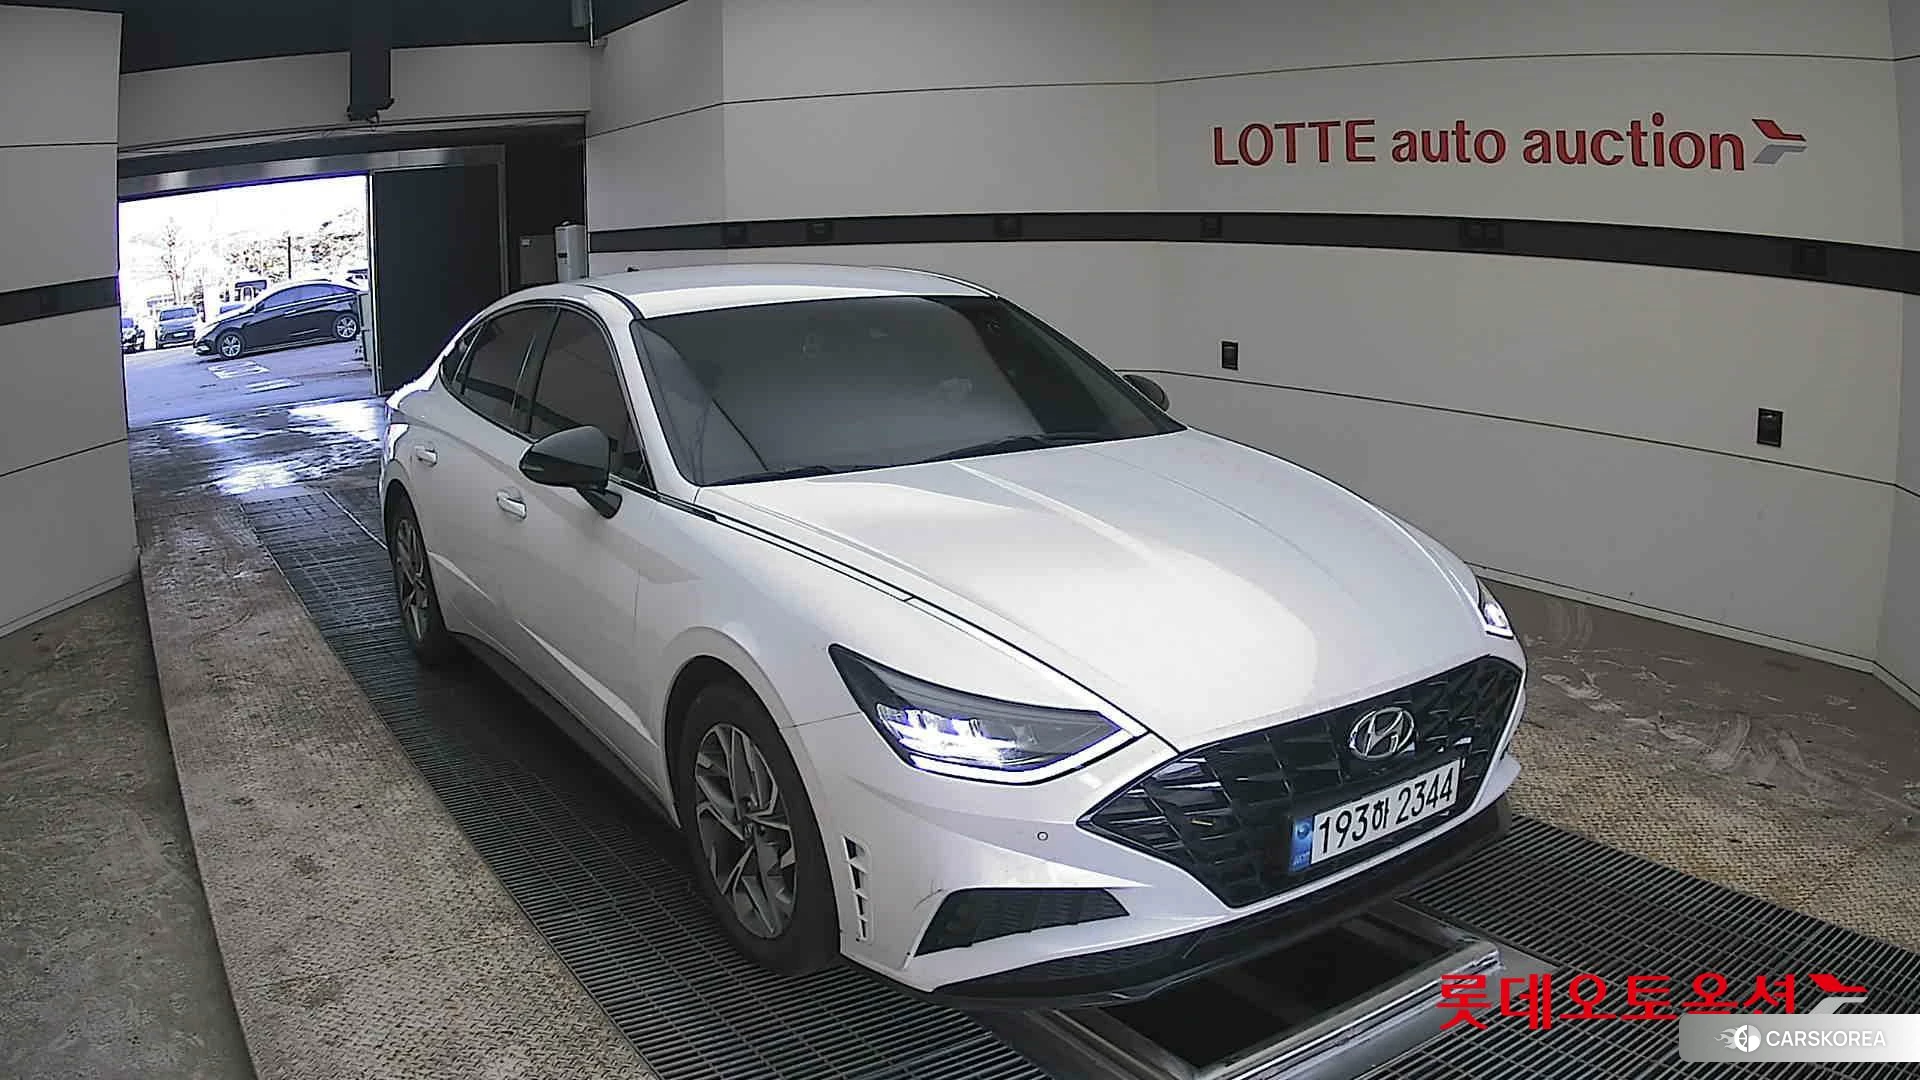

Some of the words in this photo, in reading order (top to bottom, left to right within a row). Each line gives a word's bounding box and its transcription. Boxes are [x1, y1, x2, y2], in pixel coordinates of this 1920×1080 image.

[1214, 119, 1376, 165] LOTTE
[1392, 121, 1509, 164] auto
[1523, 112, 1745, 171] auction
[1319, 797, 1390, 854] 193하
[1396, 767, 1453, 825] 2344
